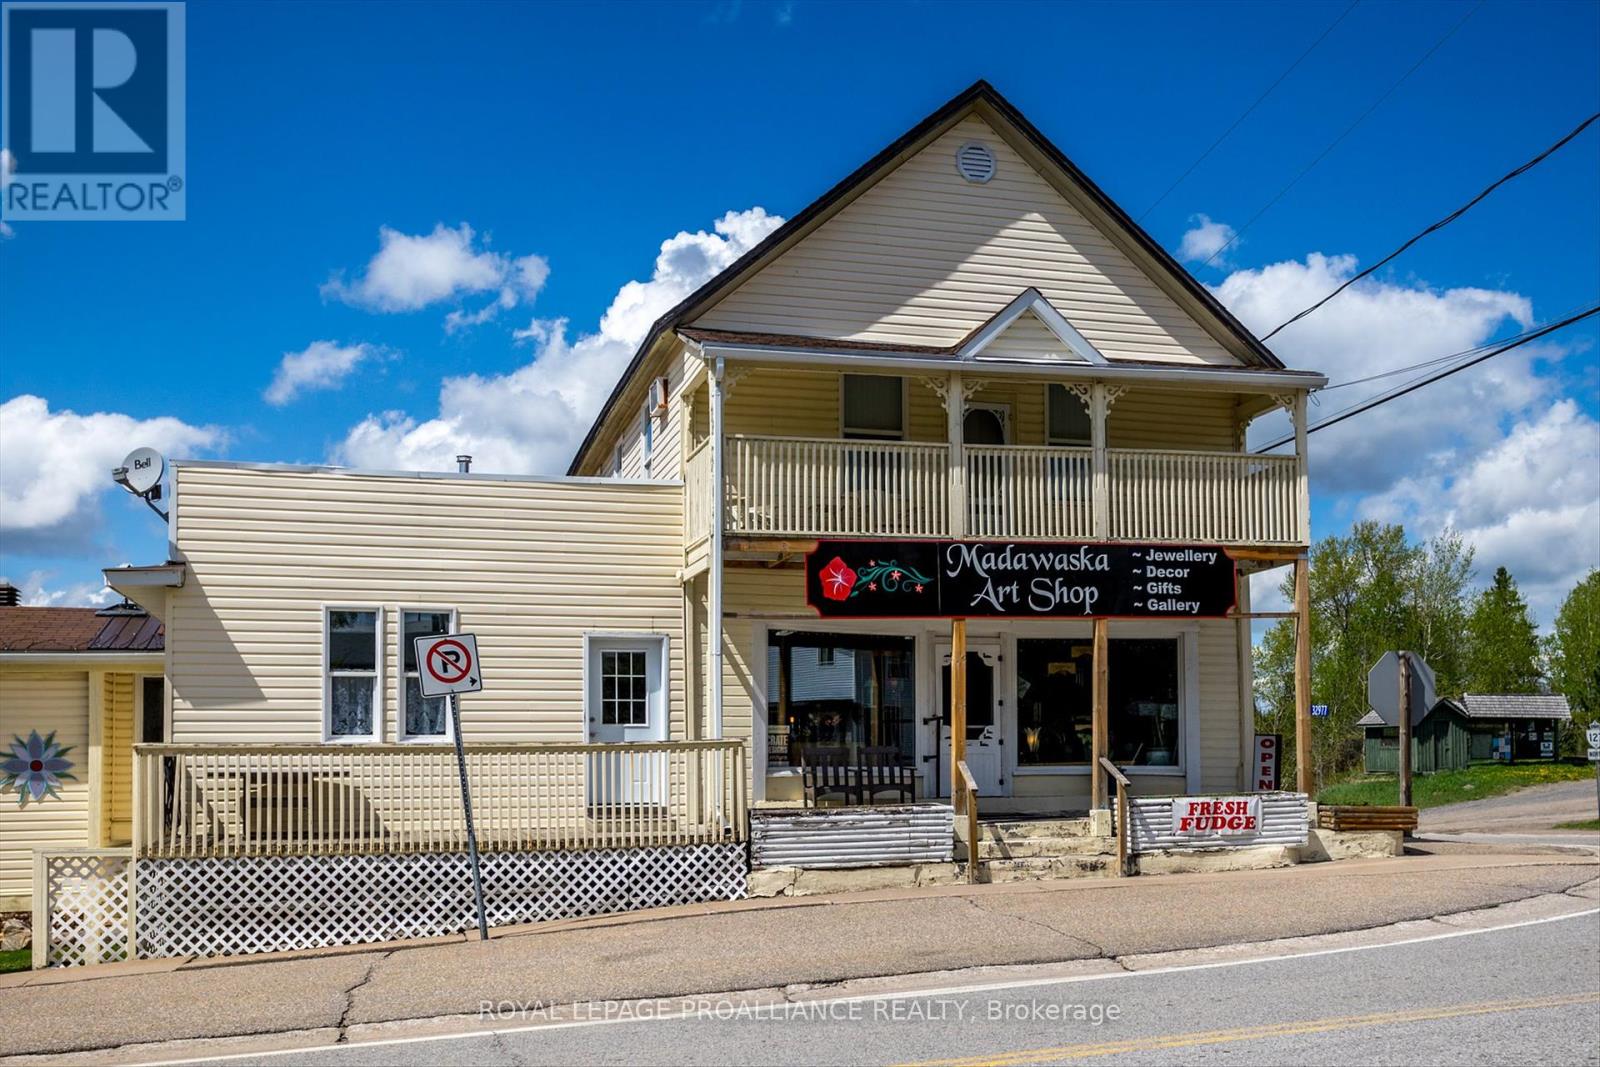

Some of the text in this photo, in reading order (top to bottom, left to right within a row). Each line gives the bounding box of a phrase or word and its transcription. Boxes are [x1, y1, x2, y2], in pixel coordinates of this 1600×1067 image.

[134, 457, 151, 470] Bell
[946, 543, 1111, 578] Madawaska
[1145, 548, 1217, 565] Jewellery
[1146, 565, 1190, 578] Decor
[970, 576, 1099, 616] Art Shop
[1146, 581, 1182, 595] Gifts
[1147, 598, 1200, 614] Gallery
[1589, 732, 1600, 743] 12
[1259, 738, 1275, 790] OPEN
[1188, 801, 1249, 816] FRESH
[1180, 815, 1257, 831] FUDGE
